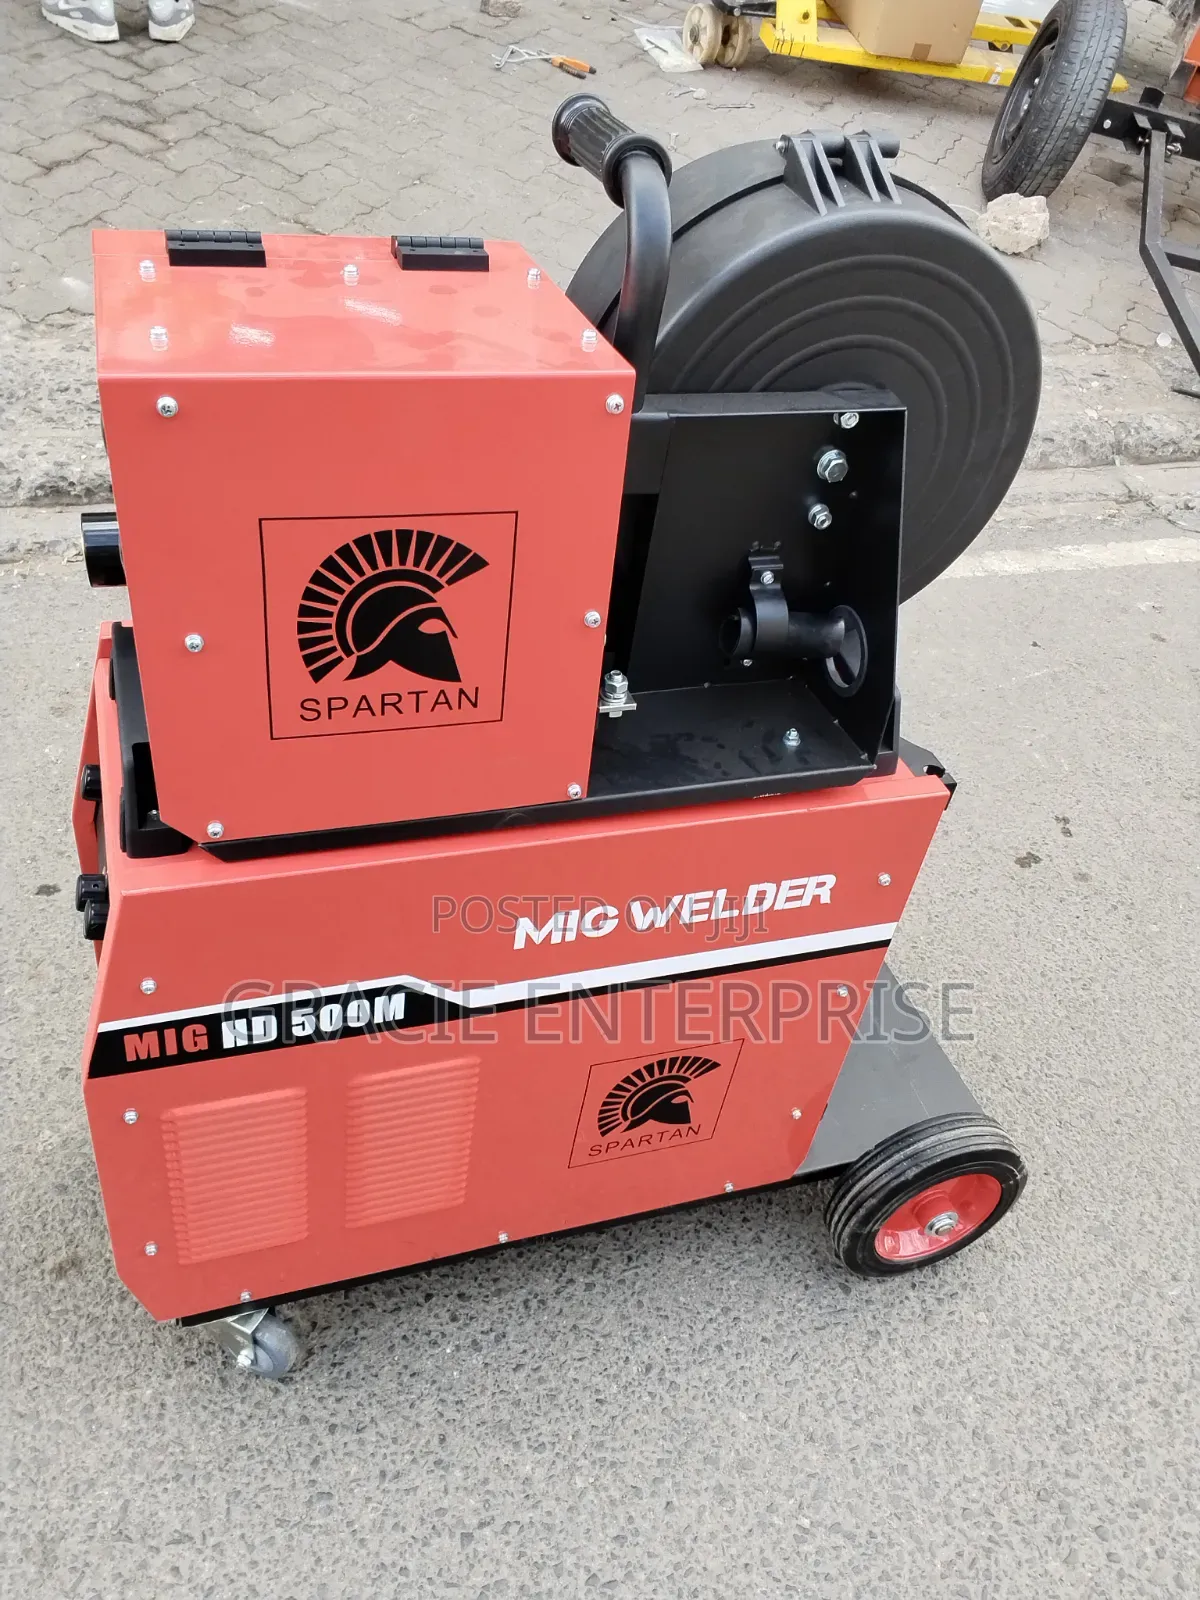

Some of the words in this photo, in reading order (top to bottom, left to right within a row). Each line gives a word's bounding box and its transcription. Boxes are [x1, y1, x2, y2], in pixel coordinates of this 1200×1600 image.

[299, 686, 479, 722] SPARTAN
[513, 905, 619, 950] MIG
[630, 874, 837, 931] WELDER
[123, 1023, 209, 1062] MIG
[221, 1014, 278, 1050] HD
[291, 992, 406, 1037] 500M
[588, 1123, 702, 1157] SPARTAN
